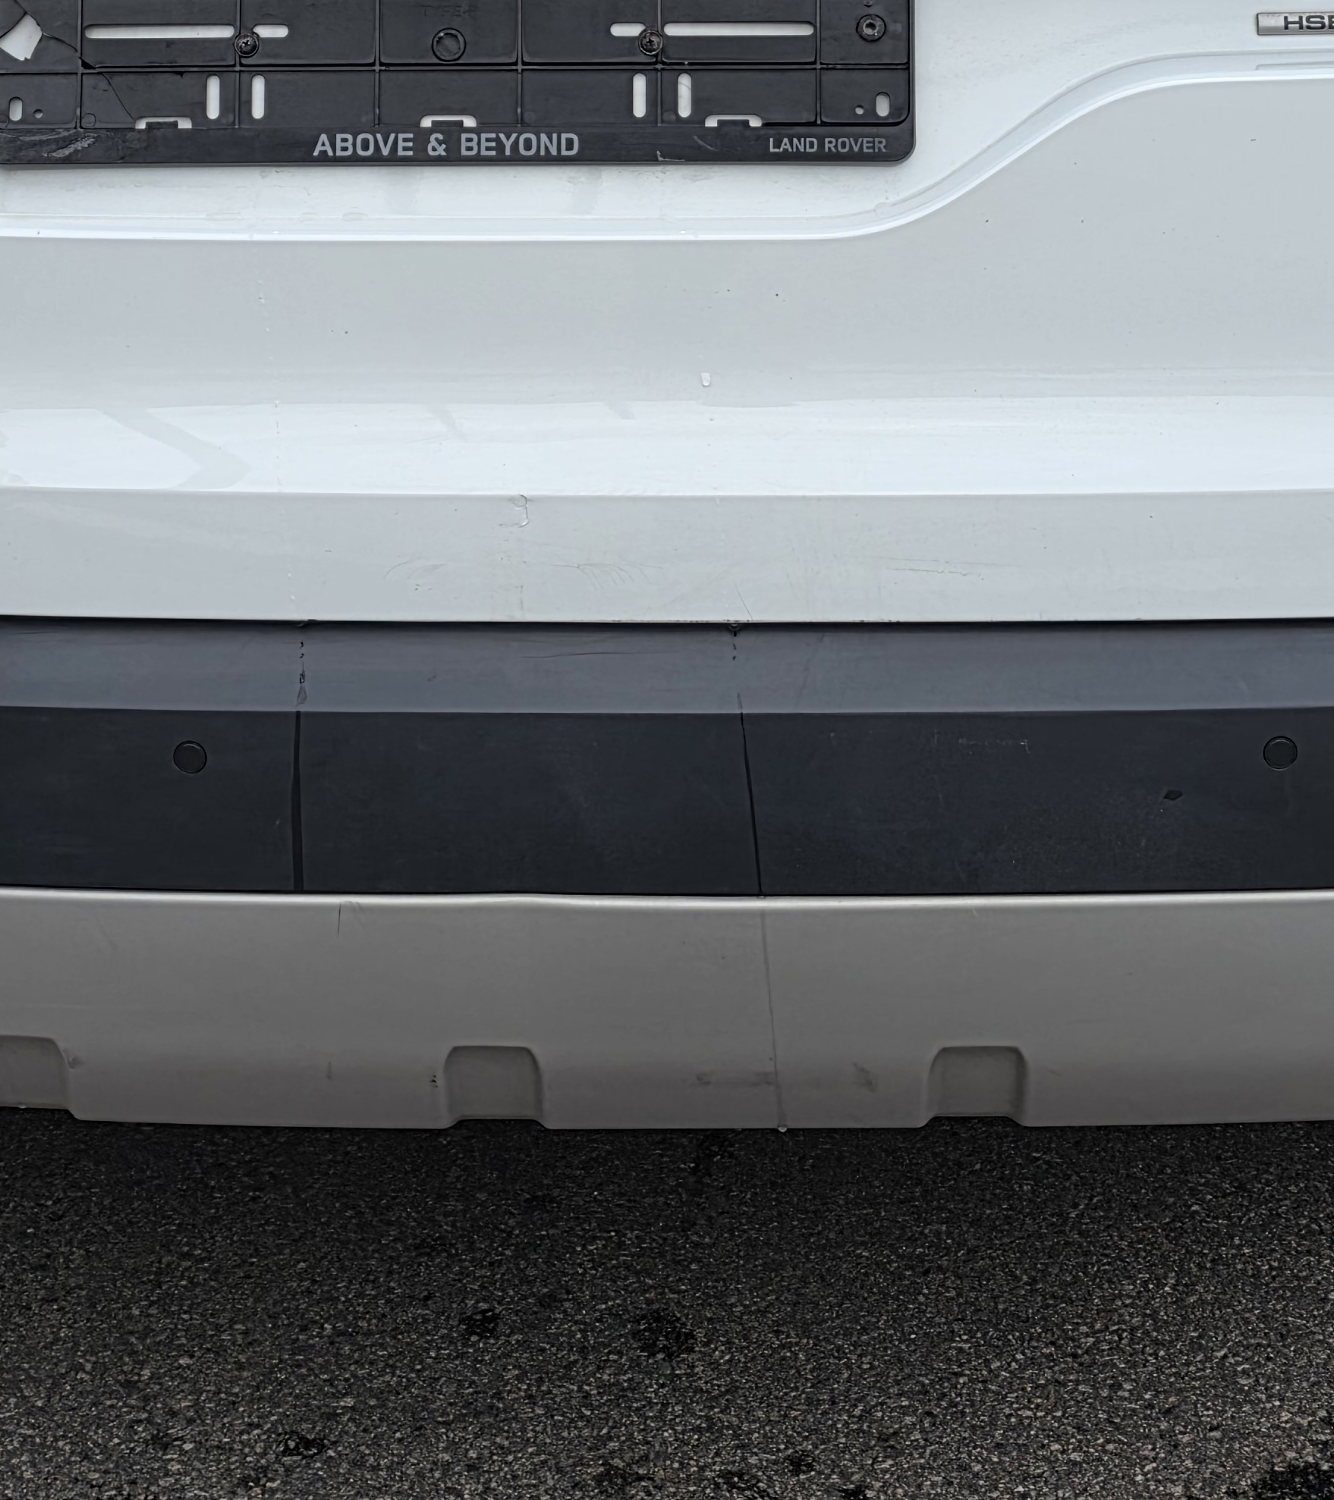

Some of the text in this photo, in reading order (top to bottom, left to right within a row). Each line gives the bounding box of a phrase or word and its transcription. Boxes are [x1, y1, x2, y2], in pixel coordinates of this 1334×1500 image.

[313, 132, 580, 157] ABOVE & BEYOND
[769, 137, 887, 153] LAND ROVER
